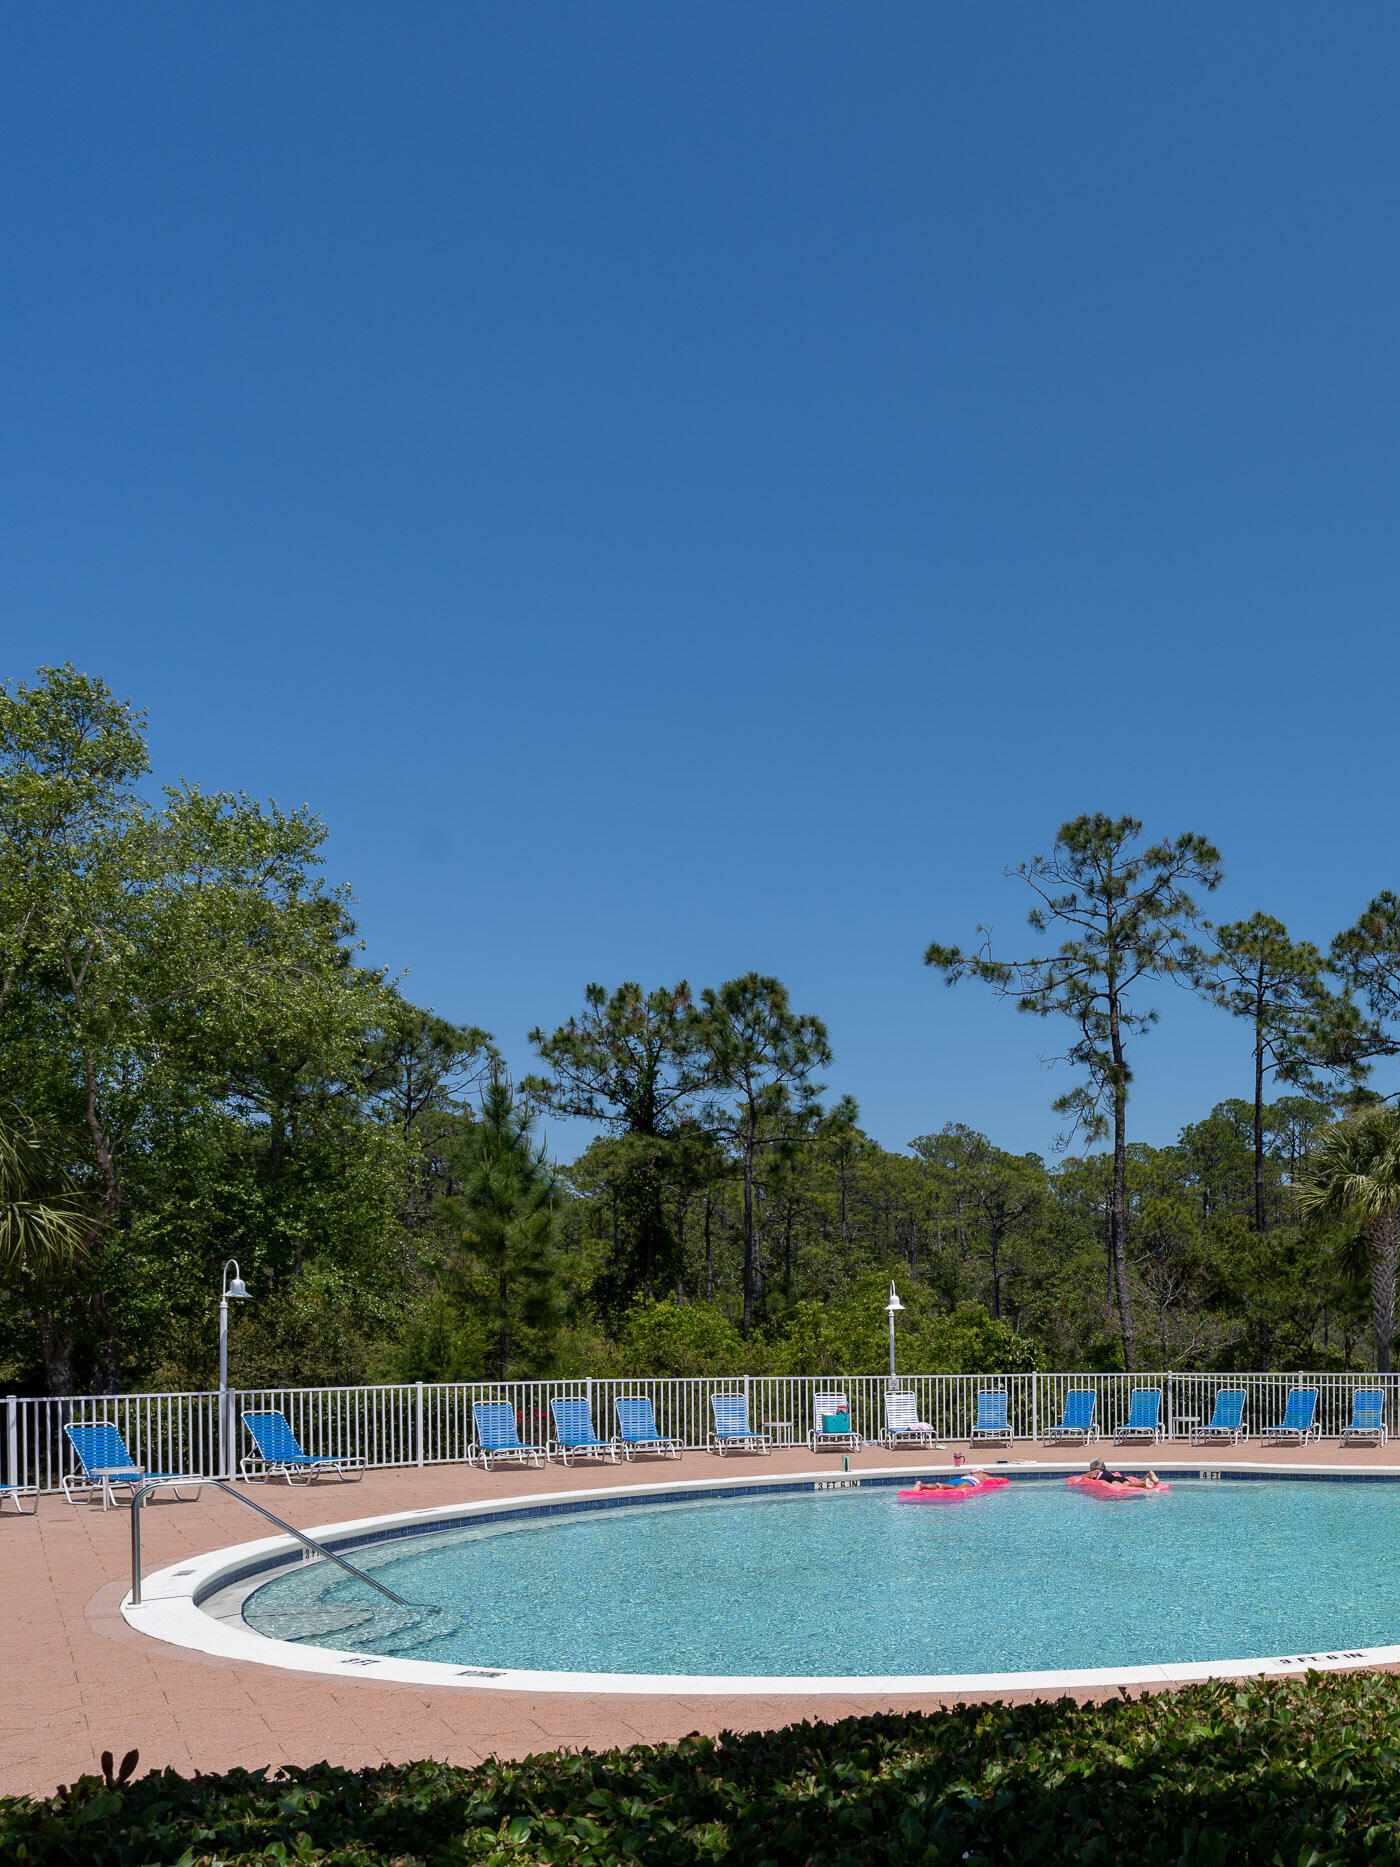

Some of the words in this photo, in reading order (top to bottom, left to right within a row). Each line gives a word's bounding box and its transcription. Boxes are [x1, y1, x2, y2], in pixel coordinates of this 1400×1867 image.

[1210, 1471, 1220, 1480] FT
[826, 1481, 837, 1489] FT
[849, 1480, 858, 1488] IN
[305, 1548, 310, 1559] 3
